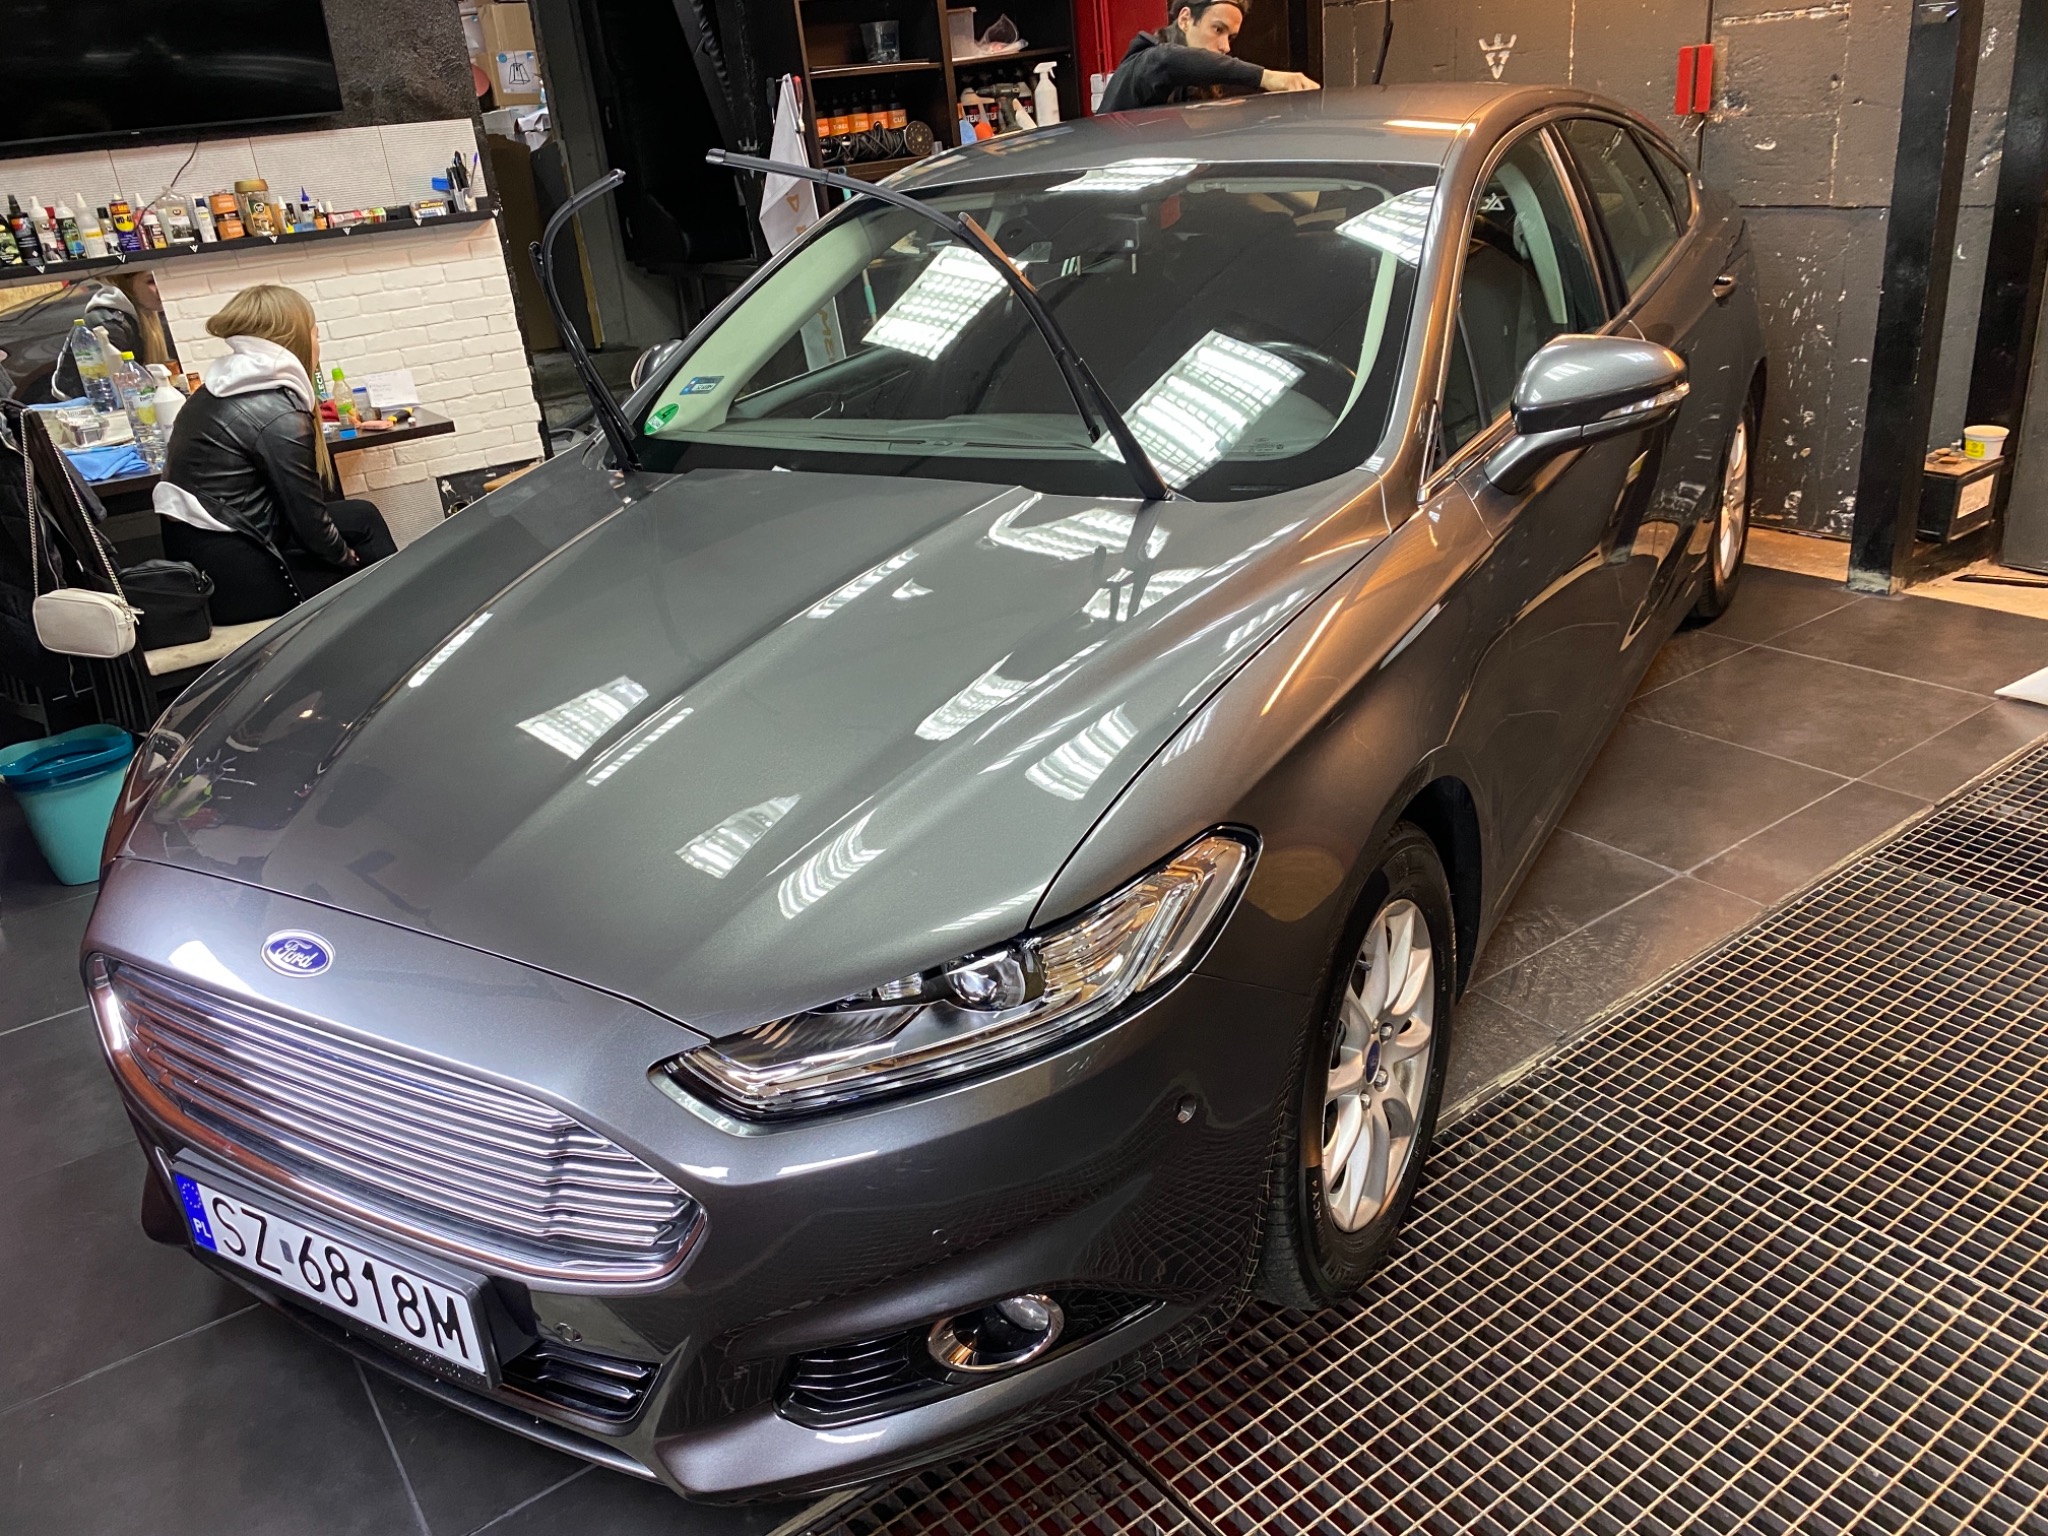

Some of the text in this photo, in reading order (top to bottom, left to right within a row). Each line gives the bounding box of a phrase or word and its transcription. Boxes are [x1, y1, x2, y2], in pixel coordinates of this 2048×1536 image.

[315, 371, 325, 394] LECH
[276, 939, 319, 968] Ford
[192, 1217, 212, 1239] PL
